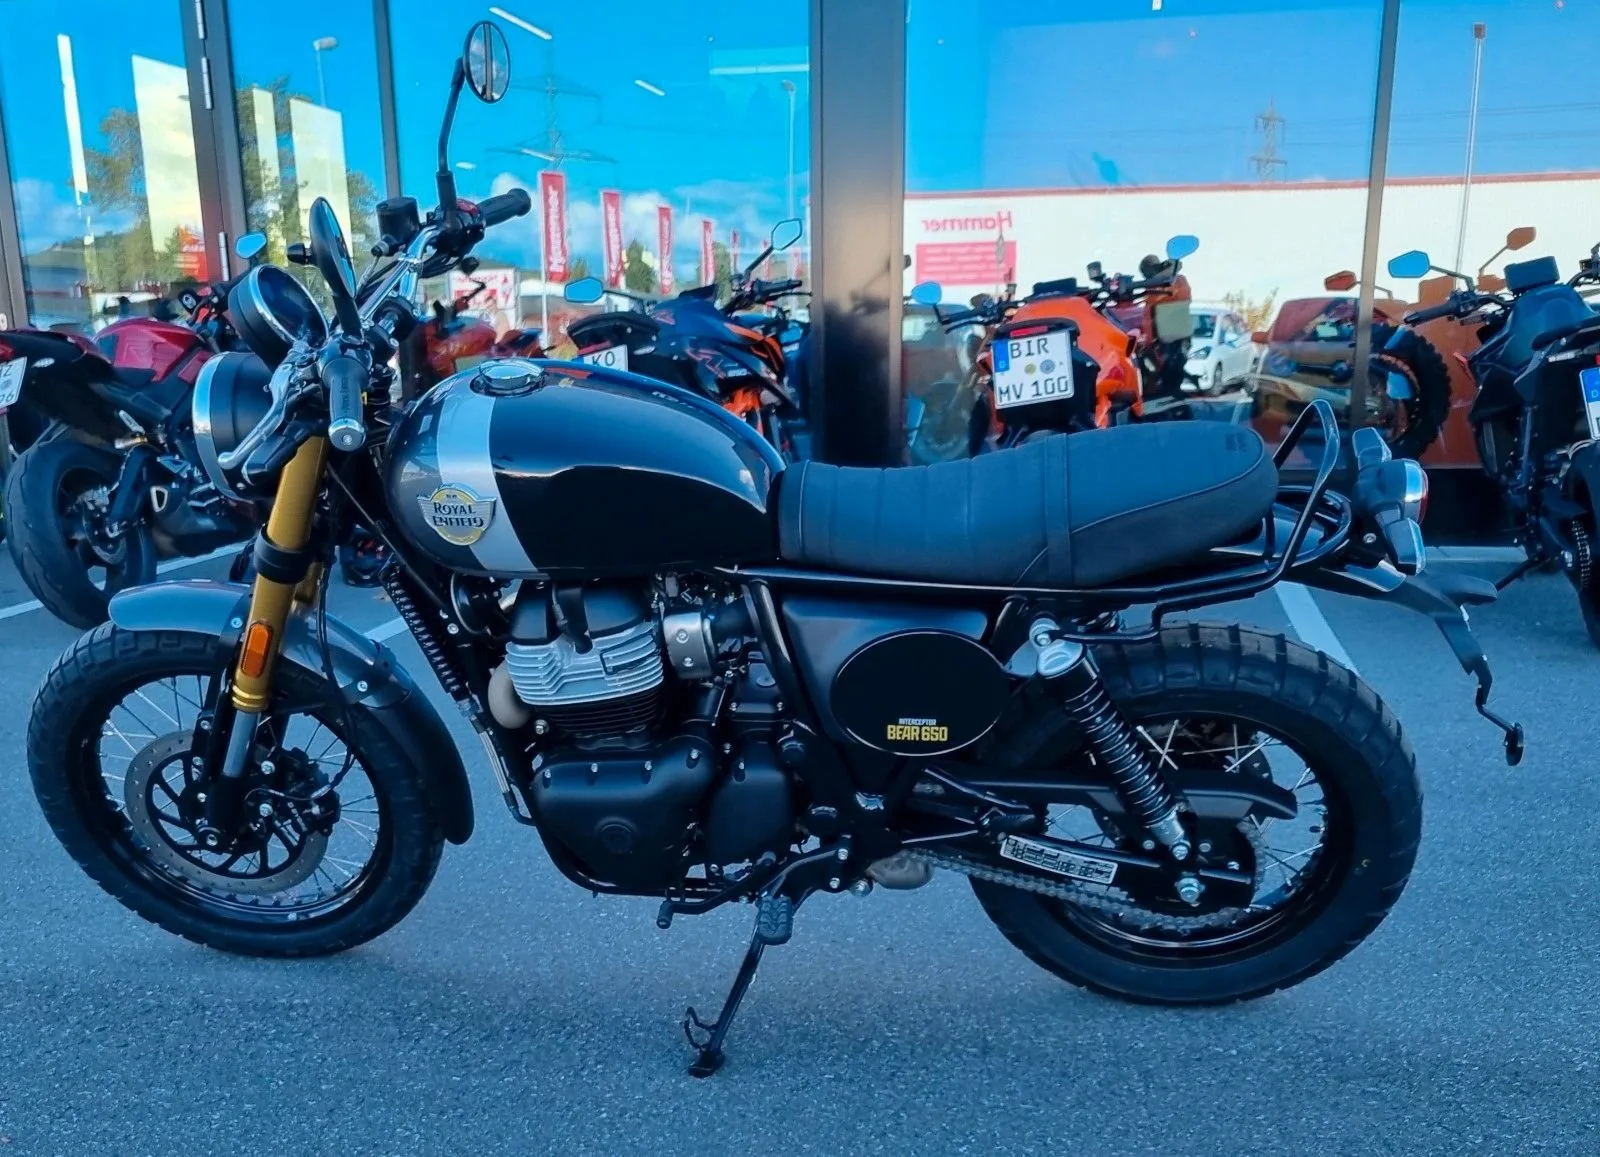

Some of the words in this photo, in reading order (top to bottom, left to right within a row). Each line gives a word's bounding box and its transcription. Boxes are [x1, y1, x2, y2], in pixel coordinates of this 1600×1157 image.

[1009, 337, 1050, 360] BIR
[998, 383, 1024, 403] MV
[1031, 376, 1069, 398] 100
[433, 502, 476, 516] ROYAL
[887, 725, 920, 741] BEAR
[921, 726, 949, 742] 650
